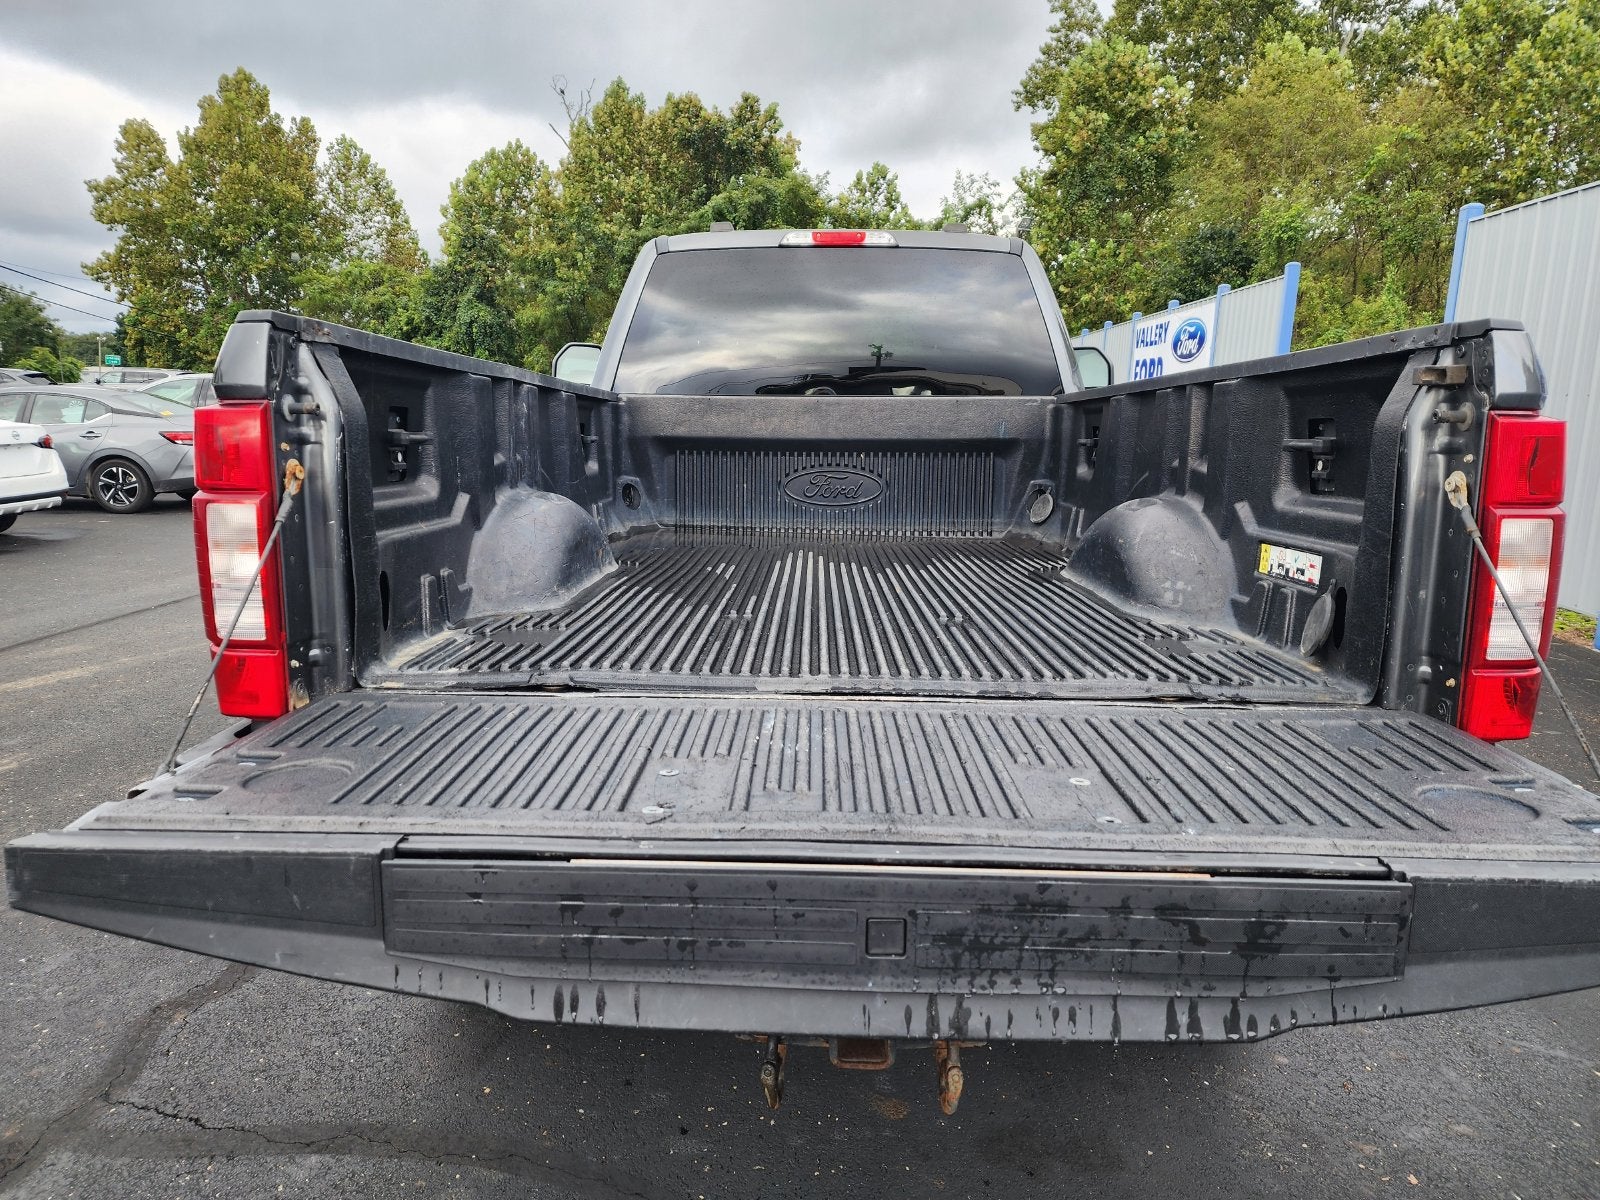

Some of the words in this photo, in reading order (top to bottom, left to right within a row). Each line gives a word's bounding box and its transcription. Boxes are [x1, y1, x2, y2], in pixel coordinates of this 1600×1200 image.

[1136, 321, 1170, 348] VALLERY
[1177, 325, 1200, 355] Ford
[1134, 356, 1163, 380] FORD
[803, 474, 864, 498] Ford
